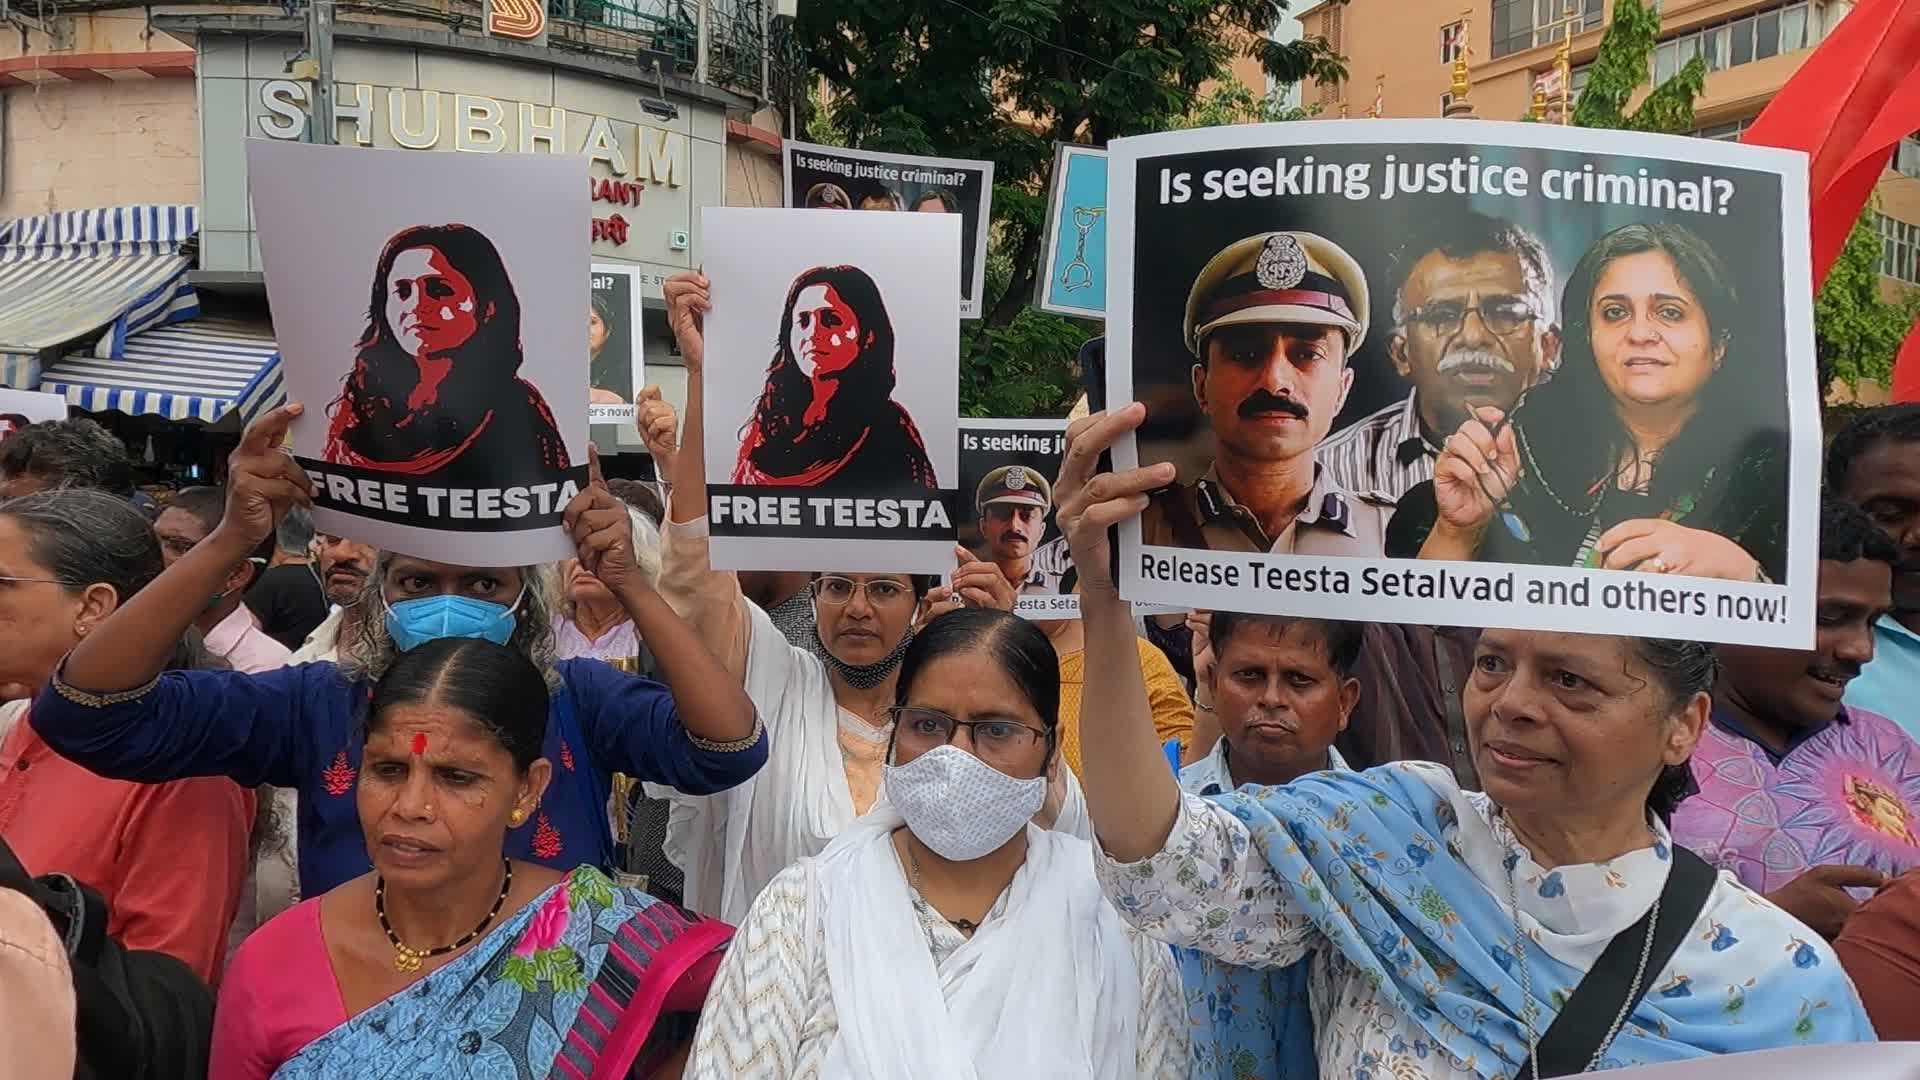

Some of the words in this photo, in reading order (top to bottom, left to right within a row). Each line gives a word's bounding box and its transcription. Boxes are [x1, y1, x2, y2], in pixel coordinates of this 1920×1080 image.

[257, 79, 688, 188] SHUBHAM
[796, 153, 806, 167] Is
[807, 156, 853, 177] seeking
[854, 162, 899, 181] justice
[901, 168, 966, 187] criminal?
[1160, 168, 1192, 205] Is
[1202, 156, 1371, 200] seeking
[1379, 154, 1529, 200] justice
[1540, 164, 1735, 216] criminal?
[963, 433, 978, 450] Is
[981, 434, 1052, 455] seeking
[304, 469, 409, 514] FREE
[417, 479, 579, 519] TEESTA
[711, 495, 801, 526] FREE
[807, 497, 952, 529] TEESTA
[1013, 602, 1047, 611] eesta
[1140, 554, 1239, 587] Release
[1249, 562, 1350, 594] Teesta
[1361, 567, 1513, 602] Setalvad
[1526, 577, 1590, 608] and
[1602, 580, 1706, 617] others
[1716, 593, 1787, 625] now!
